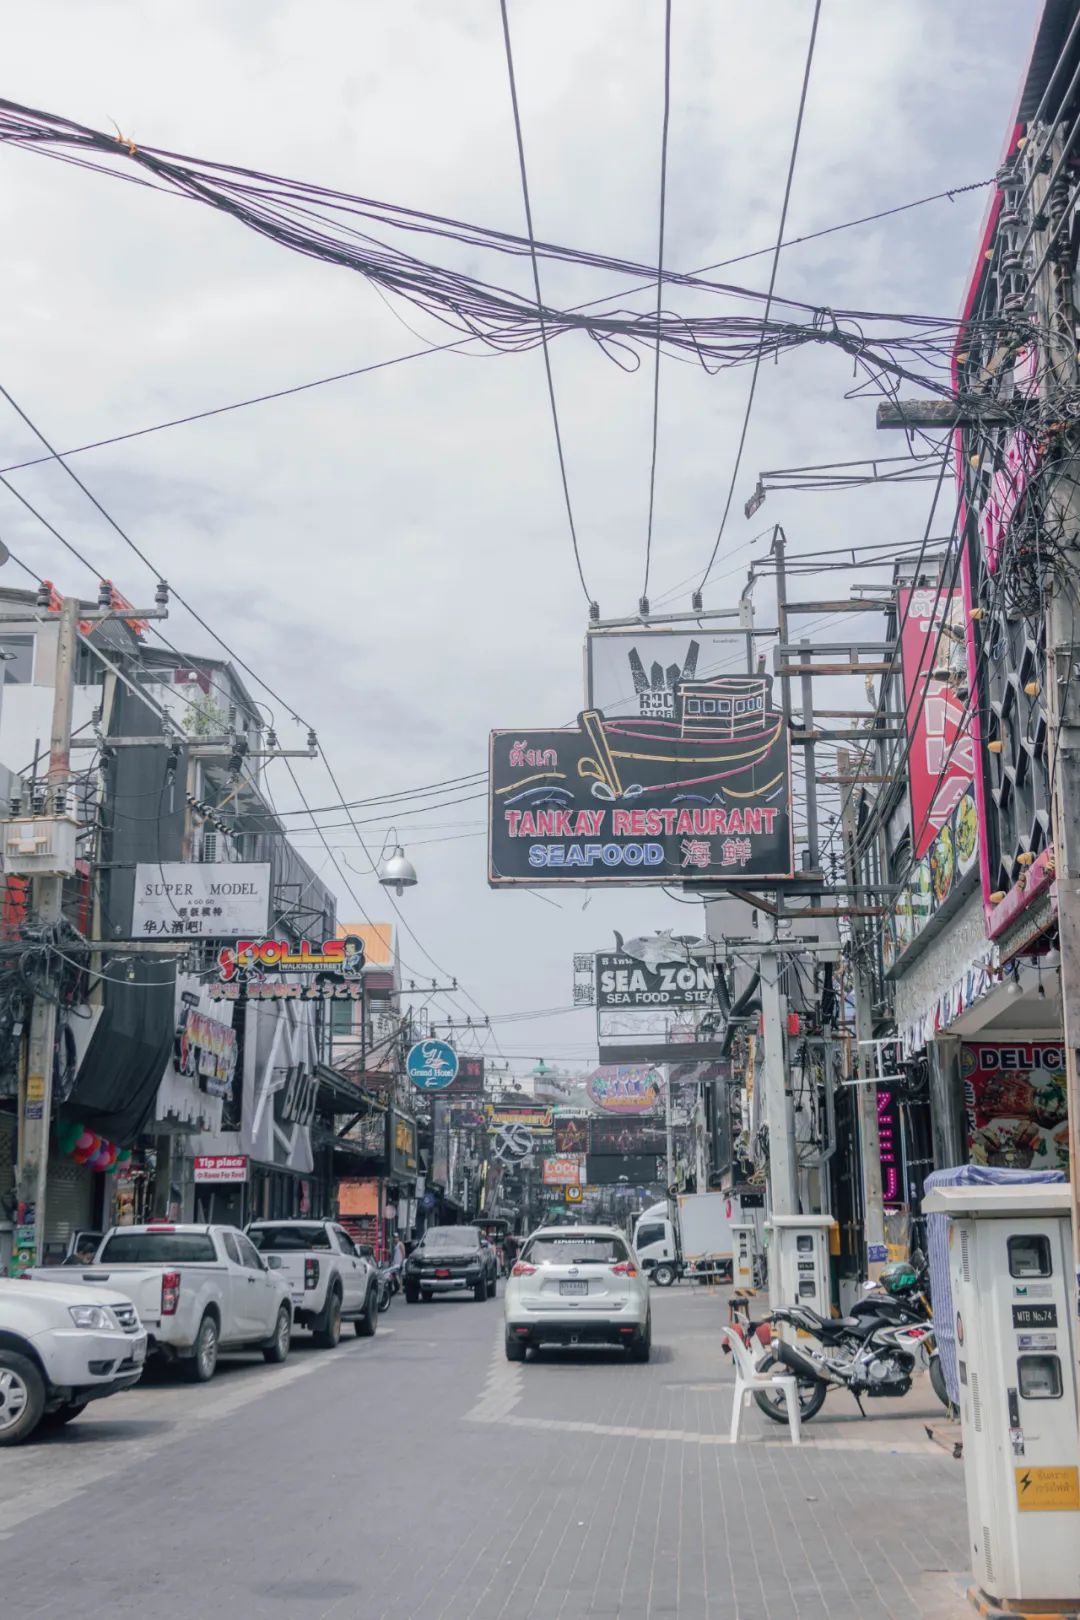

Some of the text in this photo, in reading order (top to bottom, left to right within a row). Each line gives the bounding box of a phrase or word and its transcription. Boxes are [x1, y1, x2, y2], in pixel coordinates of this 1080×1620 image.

[509, 740, 558, 767] ตังเก
[504, 807, 778, 837] TANKAY RESTAURANT
[528, 843, 665, 867] SEAFOOD
[145, 882, 259, 896] SUPER MODEL
[144, 920, 203, 934] 华人酒吧!
[236, 940, 346, 967] DOLLS
[601, 967, 716, 992] SEA ZON
[607, 993, 631, 1004] SEA
[635, 991, 670, 1003] FOOD
[199, 1157, 215, 1168] Tip
[1032, 1309, 1053, 1321] No.74
